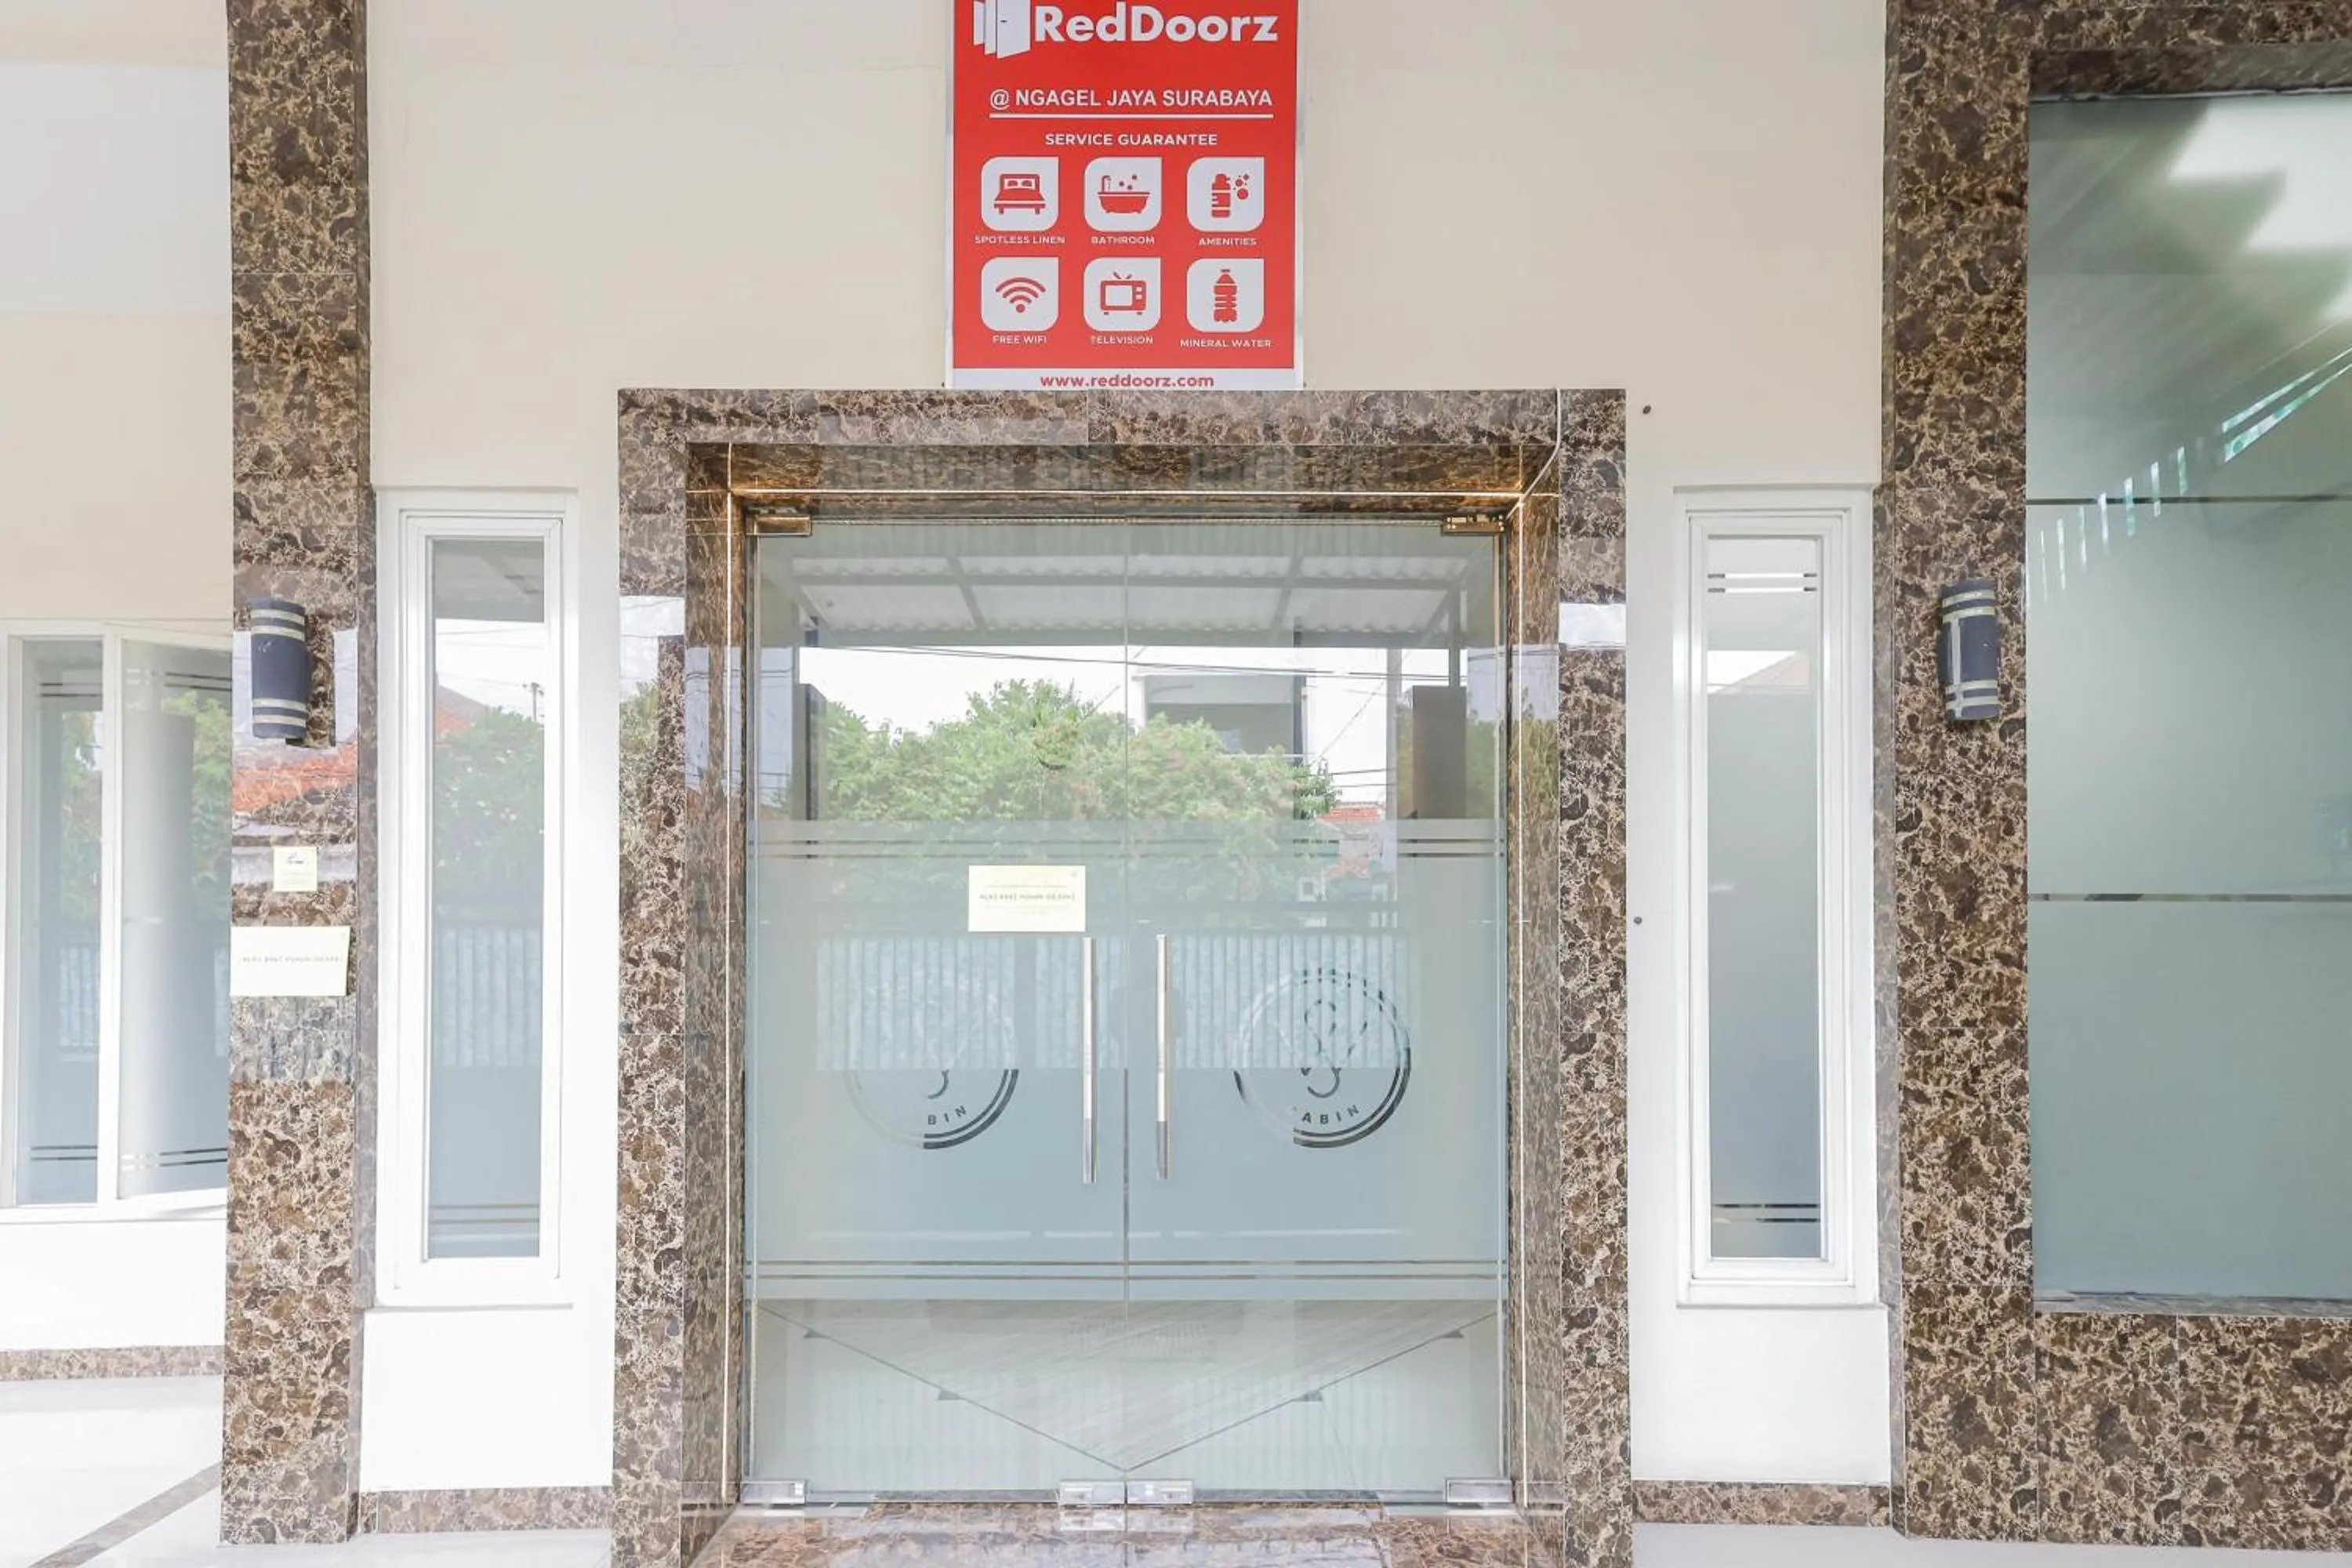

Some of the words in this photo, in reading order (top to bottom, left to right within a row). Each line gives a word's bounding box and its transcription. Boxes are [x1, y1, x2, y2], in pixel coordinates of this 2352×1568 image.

[1035, 1, 1278, 42] RedDoorz
[990, 89, 1010, 111] @
[1015, 89, 1102, 107] NGAGEL
[1106, 89, 1157, 107] JAYA
[1163, 89, 1272, 107] SURABAYA
[1045, 133, 1112, 146] SERVICE
[1117, 133, 1218, 146] GUARANTEE
[975, 235, 1029, 245] SPOTLESS
[1091, 236, 1155, 245] BATHROOM
[993, 335, 1020, 344] FREE
[1023, 335, 1047, 344] WIFI
[1091, 335, 1153, 344] TELEVISION
[1180, 339, 1229, 347] MINERAL
[1231, 339, 1271, 348] WATER
[1040, 374, 1214, 387] www.reddoorz.com
[927, 1105, 967, 1125] BIN
[1301, 1105, 1359, 1125] ABIN
